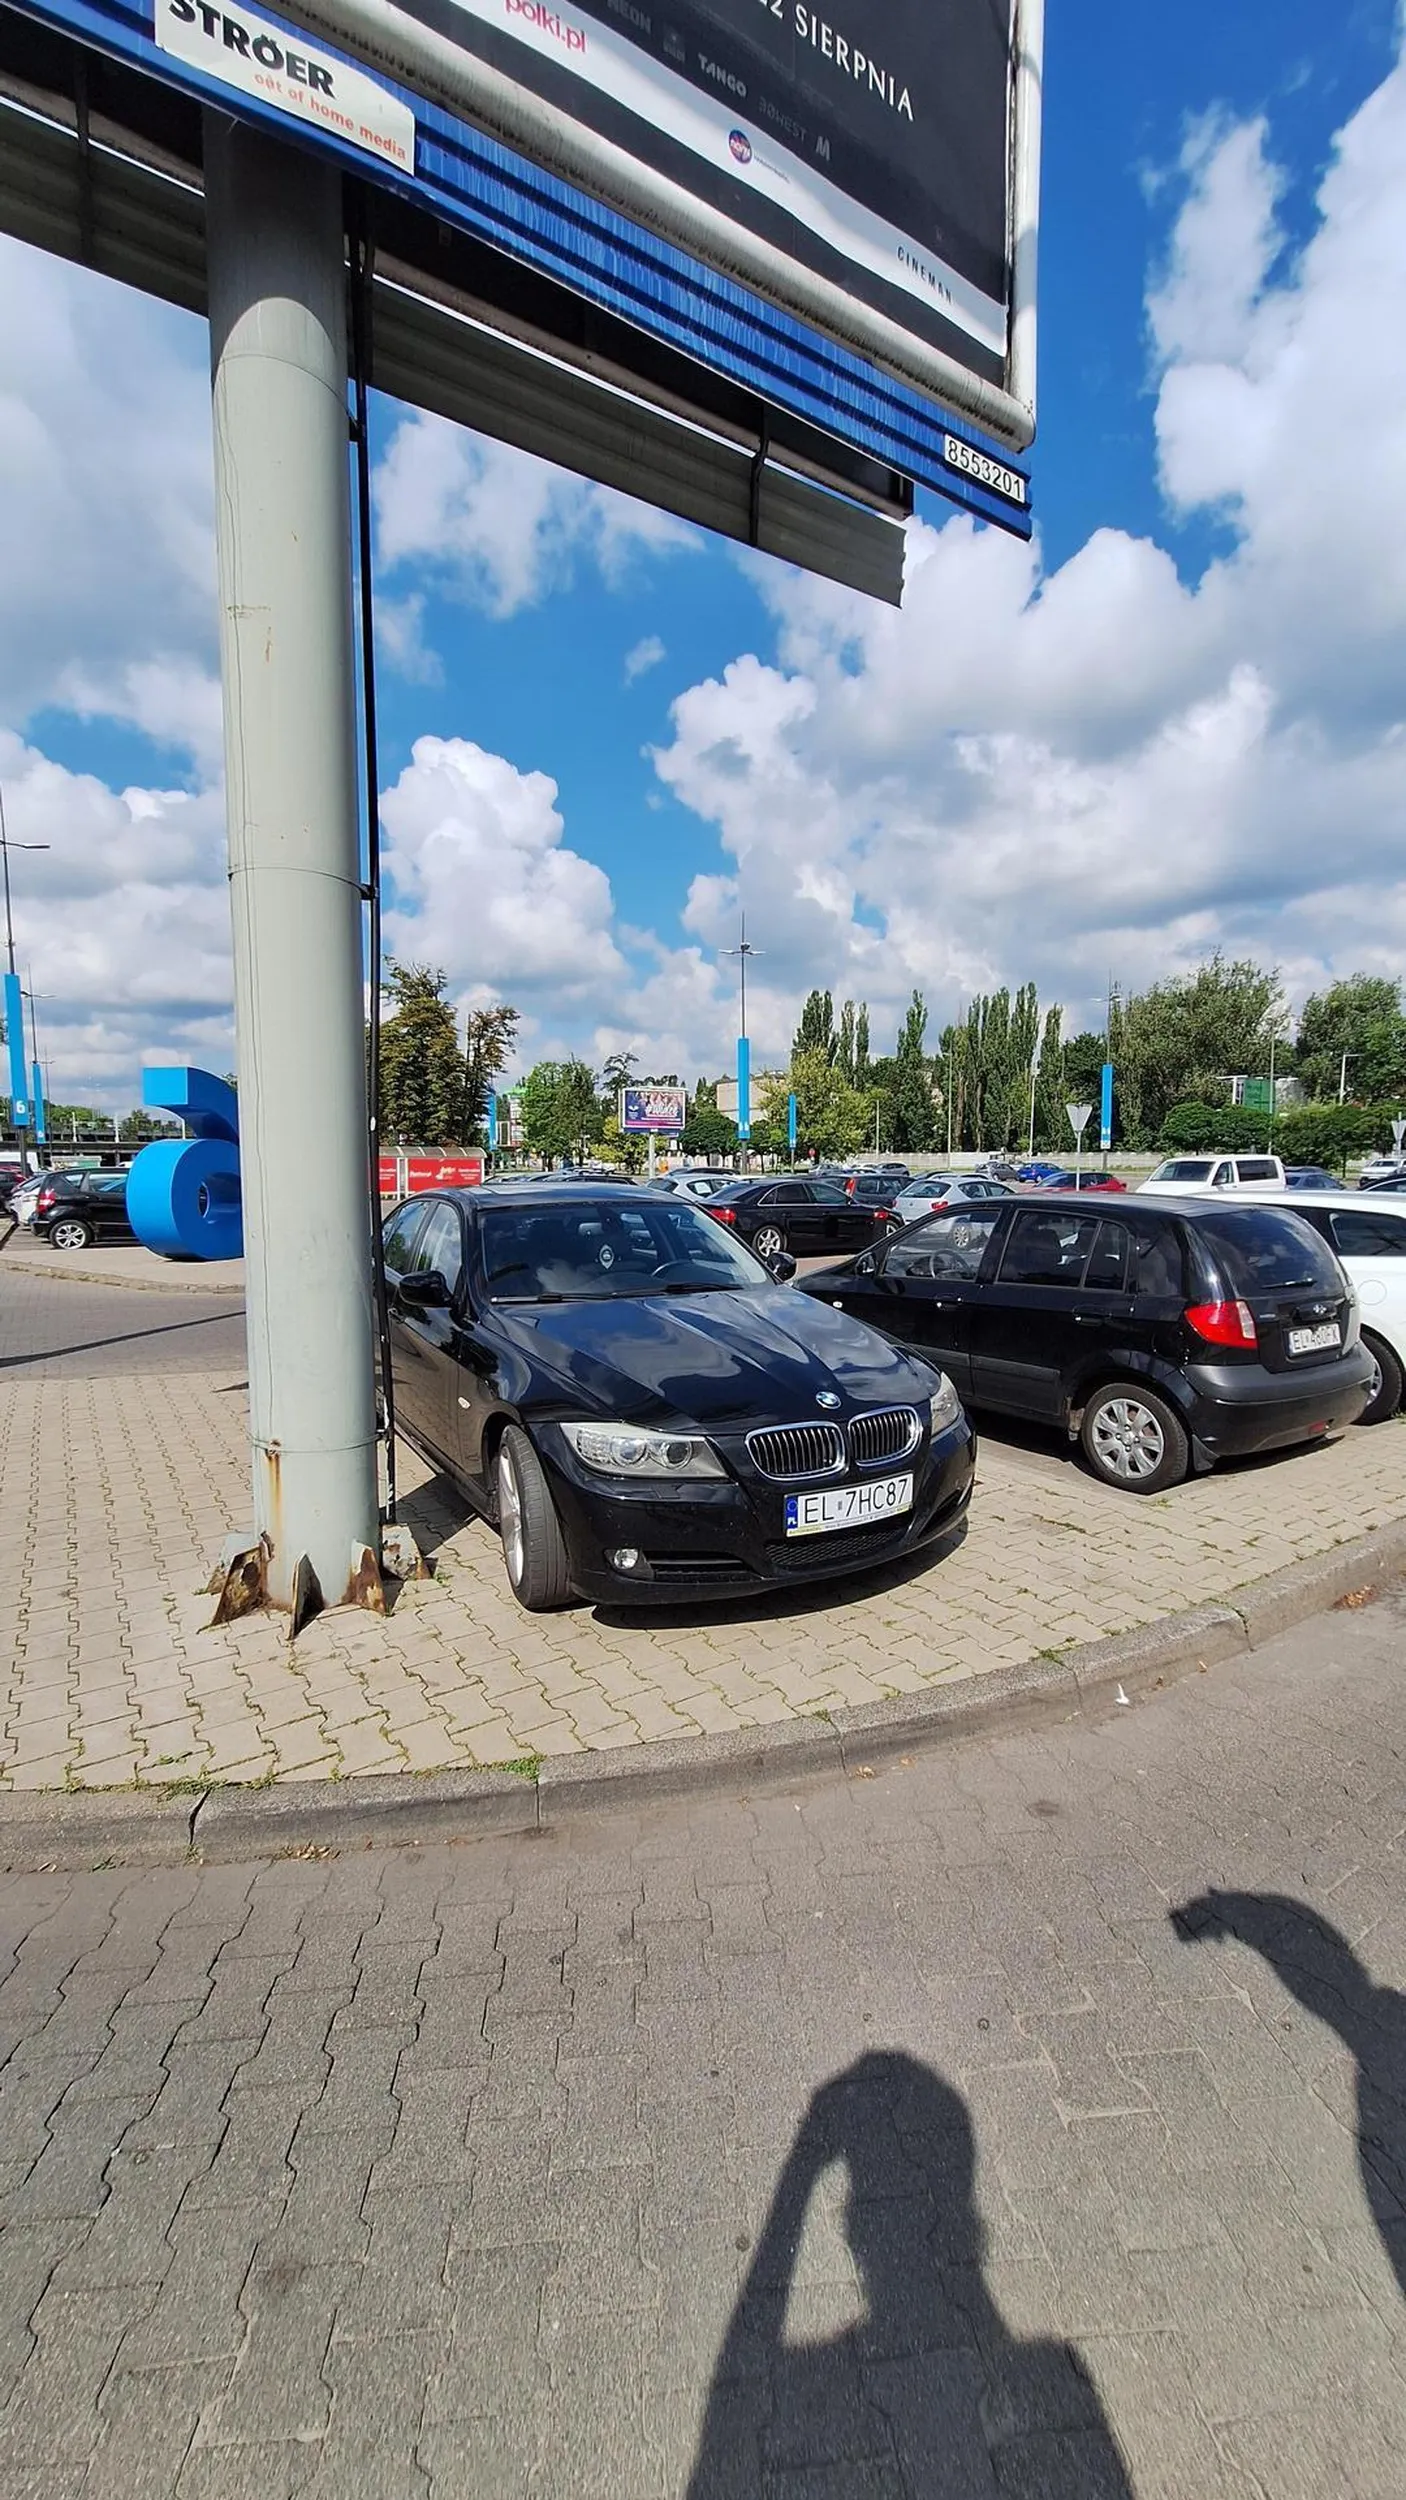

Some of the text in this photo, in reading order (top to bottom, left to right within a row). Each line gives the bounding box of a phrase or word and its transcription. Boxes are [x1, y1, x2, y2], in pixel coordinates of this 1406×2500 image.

[169, 0, 335, 98] STRÖER
[698, 53, 748, 97] TANGO
[795, 4, 914, 122] SIERPNIA
[288, 88, 306, 104] of
[310, 95, 354, 131] home
[359, 125, 407, 160] media
[897, 245, 952, 304] CINEMAN
[948, 440, 1021, 499] 8553201
[16, 1100, 26, 1114] 6
[804, 1496, 834, 1524] EL
[846, 1479, 908, 1517] 7HC87
